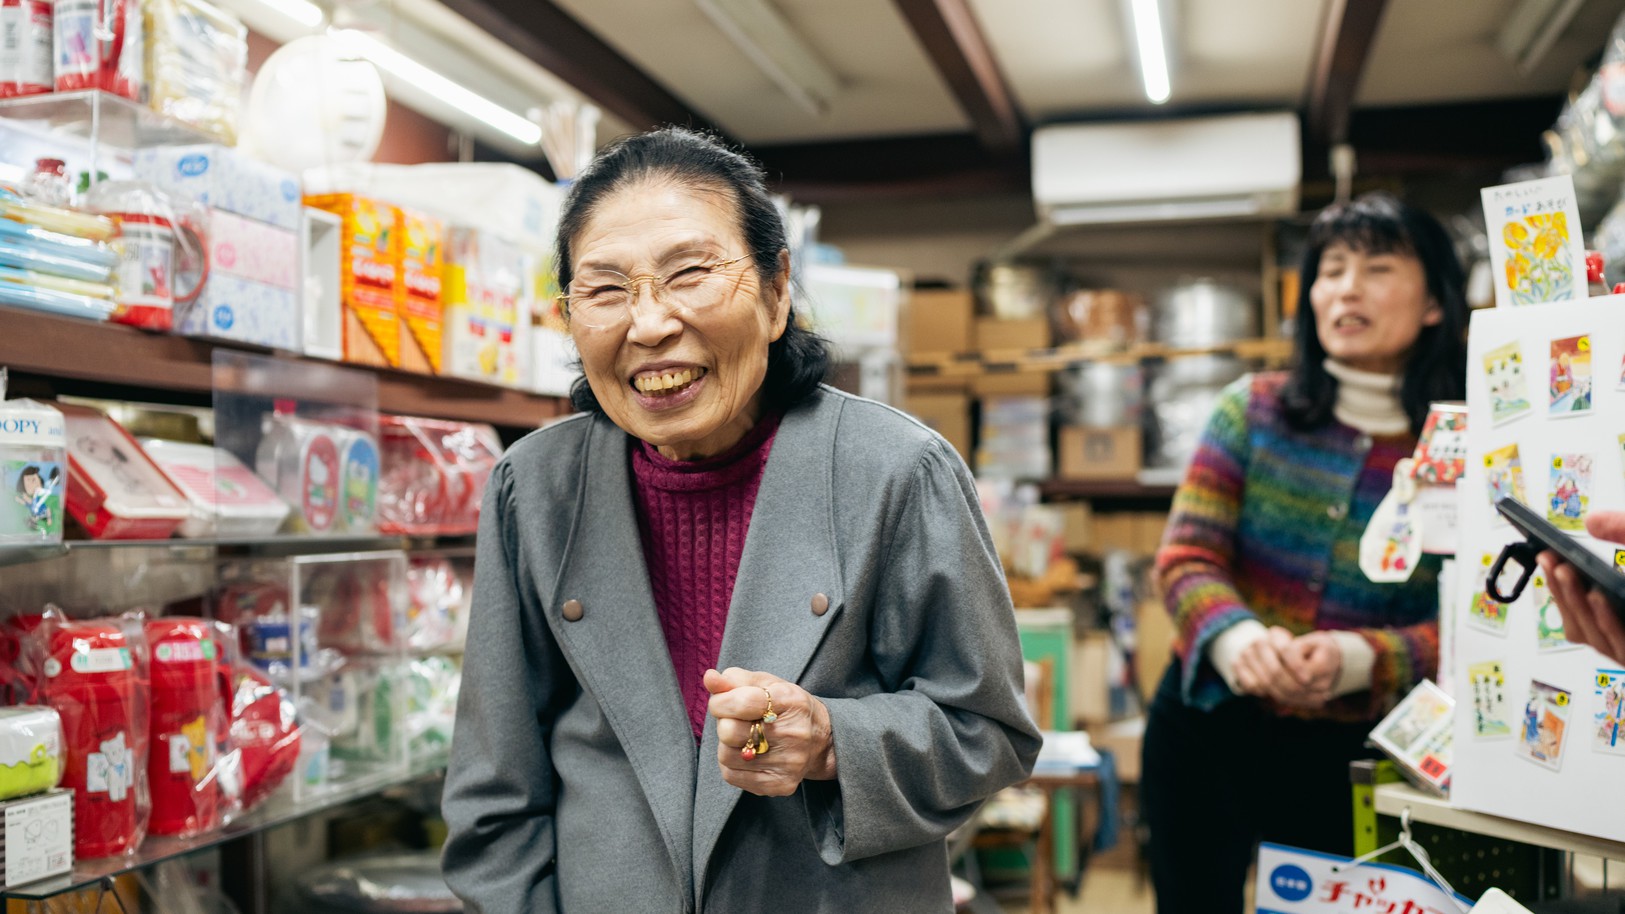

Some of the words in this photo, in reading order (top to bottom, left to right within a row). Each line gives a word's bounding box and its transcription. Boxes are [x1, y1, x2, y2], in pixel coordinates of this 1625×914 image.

[0, 419, 41, 434] OPY
[1318, 879, 1445, 914] チャッカ
